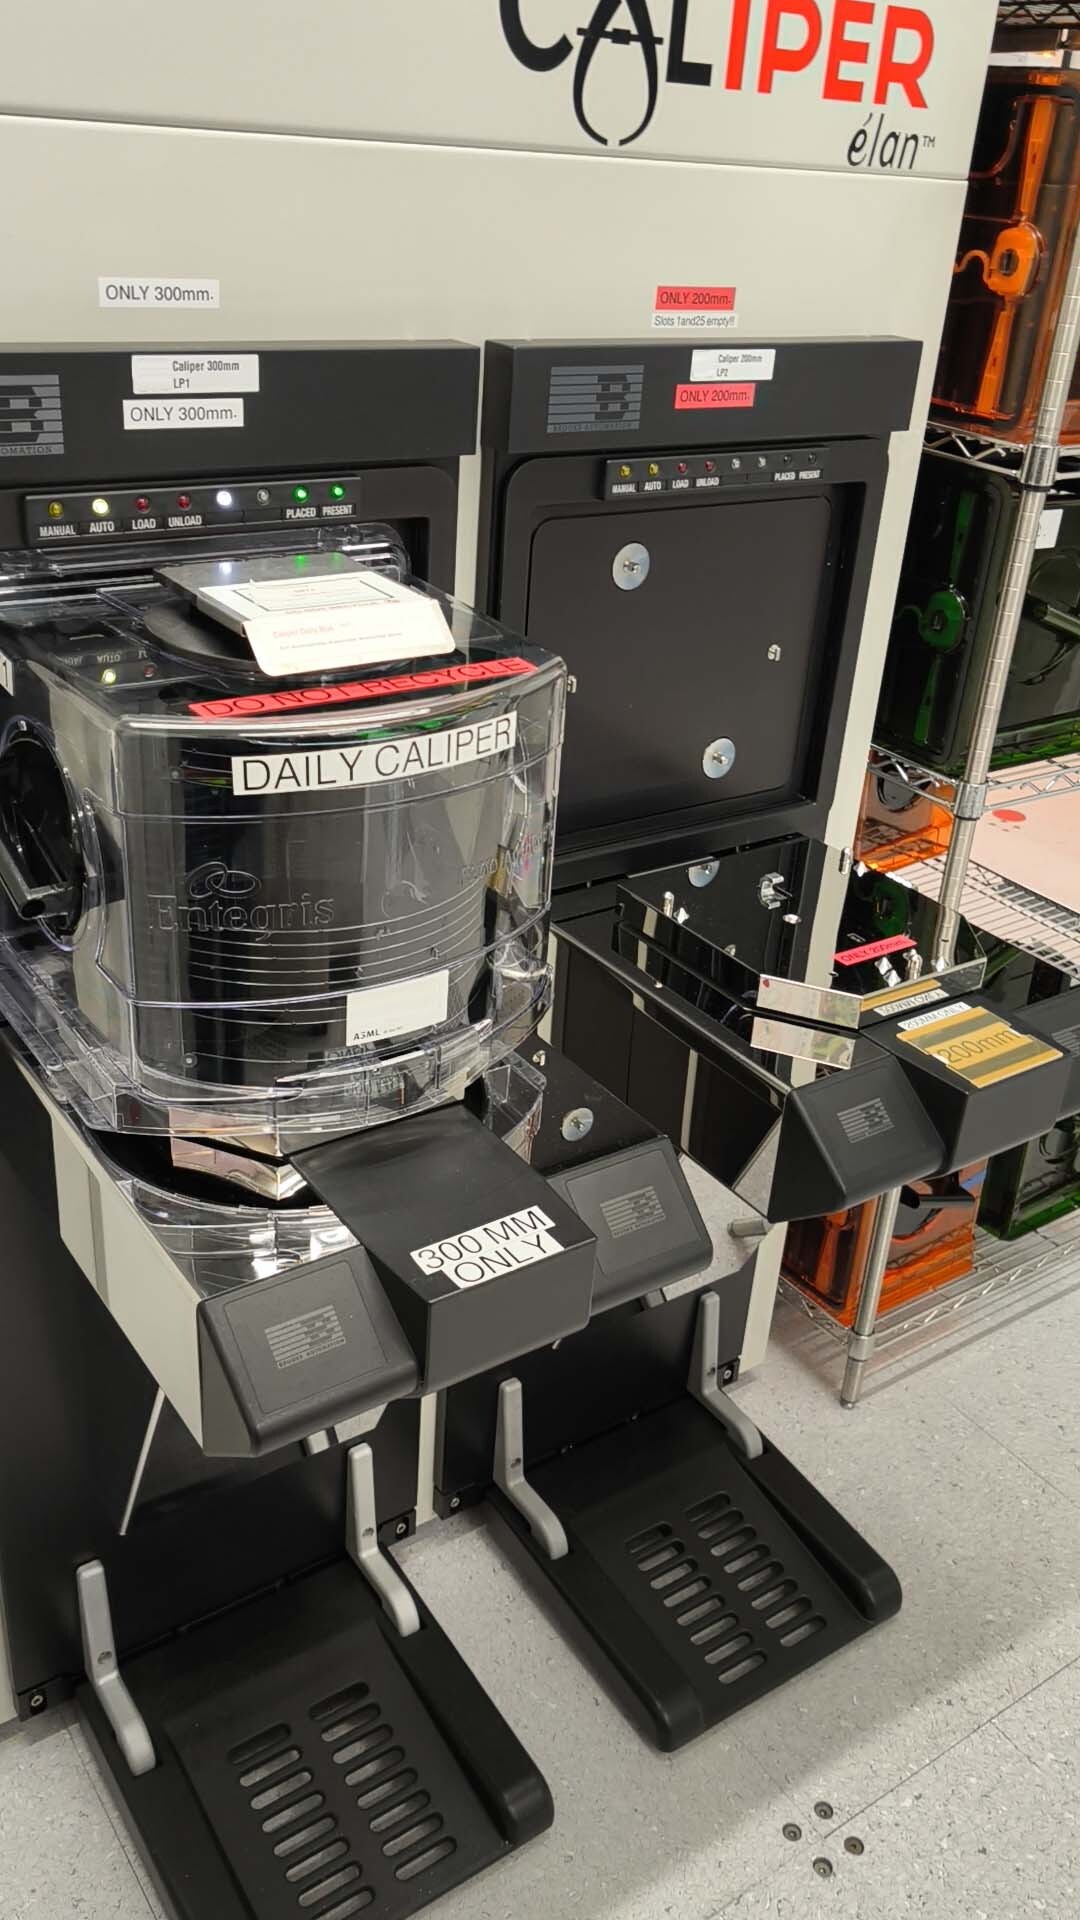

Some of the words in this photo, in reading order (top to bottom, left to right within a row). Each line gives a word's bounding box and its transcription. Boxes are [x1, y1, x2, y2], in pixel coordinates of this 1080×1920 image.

[498, 0, 935, 147] CALIPER
[105, 284, 150, 302] ONLY
[660, 290, 691, 305] ONLY
[654, 315, 675, 327] Slots
[171, 359, 205, 374] Caliper
[206, 359, 240, 372] 300mm
[718, 353, 740, 365] Caliper
[740, 353, 763, 363] 200mm
[716, 367, 729, 378] LP2
[172, 377, 191, 390] LP1
[680, 389, 710, 403] ONLY
[130, 405, 174, 423] ONLY
[611, 484, 637, 494] MANUAL
[644, 481, 662, 492] AUTO
[672, 479, 690, 489] LOAD
[696, 477, 720, 488] UNLOAD
[774, 472, 796, 482] PLACED
[799, 469, 822, 480] PRESENT
[39, 524, 77, 538] MANUAL
[89, 520, 116, 534] AUTO
[131, 517, 157, 531] LOAD
[168, 513, 203, 529] UNLOAD
[285, 505, 317, 520] PLACED
[321, 503, 353, 517] PRESENT
[200, 699, 240, 716] DO
[275, 682, 350, 707] NOT
[367, 658, 532, 690] RECYCLE
[242, 749, 362, 792] DAILY
[374, 716, 512, 778] CALIPER
[149, 892, 336, 943] Entegris
[936, 1027, 1022, 1065] 200mm
[416, 1231, 482, 1271] 300
[488, 1208, 549, 1245] MM
[453, 1231, 552, 1285] ONLY
